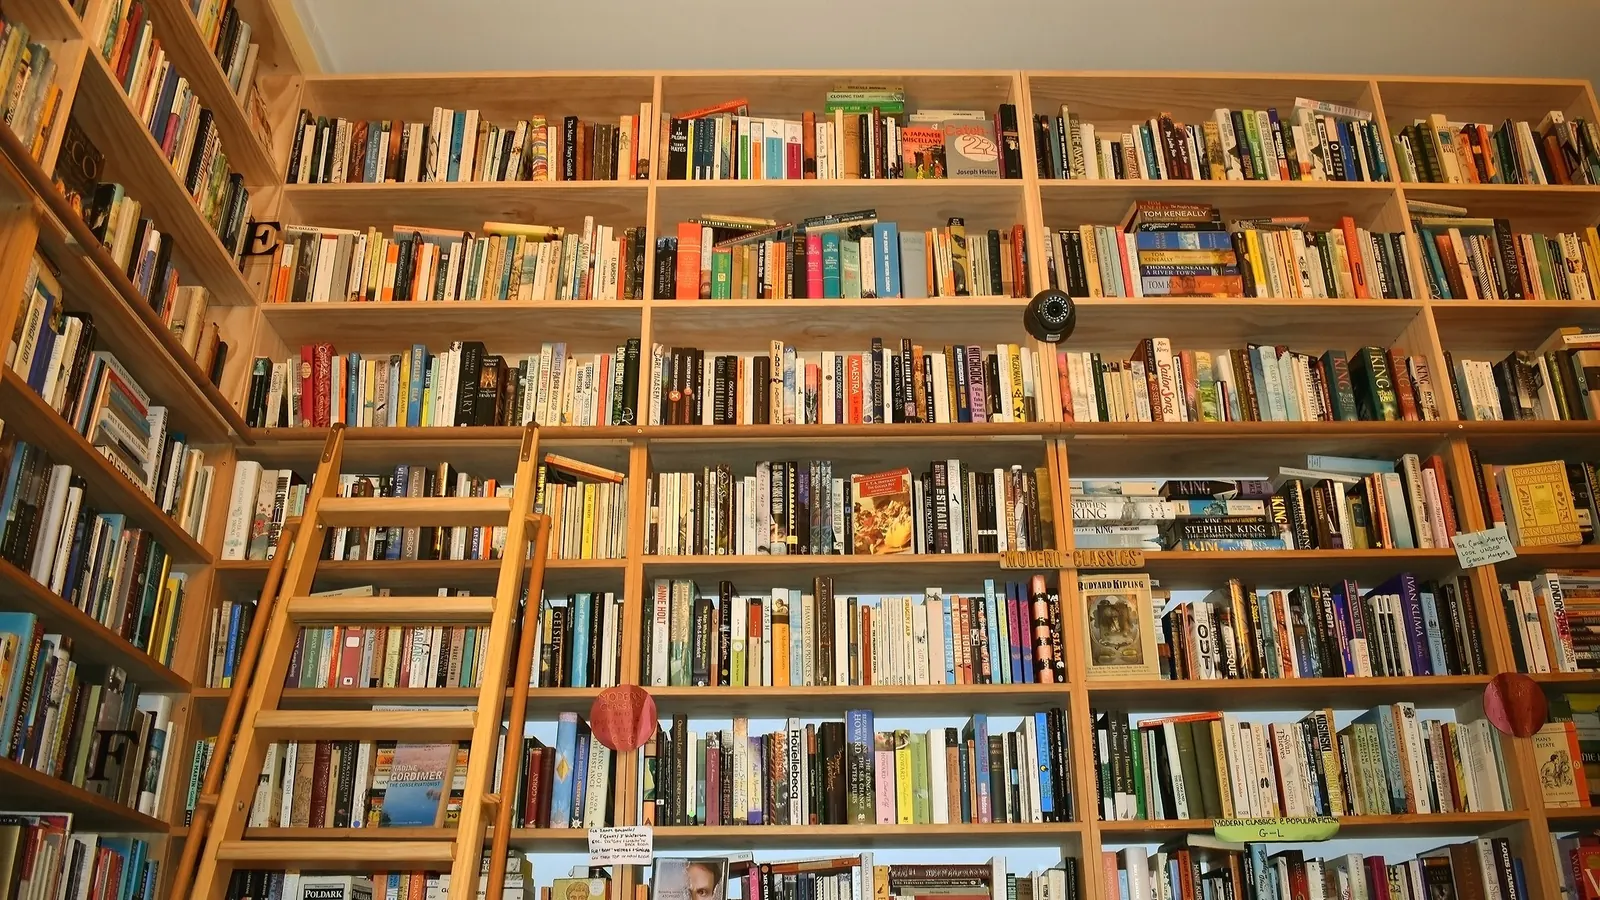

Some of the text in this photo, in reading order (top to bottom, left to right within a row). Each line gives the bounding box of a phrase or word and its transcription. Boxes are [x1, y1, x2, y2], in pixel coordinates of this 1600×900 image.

[1144, 210, 1207, 218] TOM KENEALLY
[246, 221, 281, 255] E
[1147, 277, 1166, 288] TOM
[615, 347, 625, 384] DON BUENO
[968, 347, 982, 385] HITCHCOCK
[1012, 354, 1021, 386] PILGERMANN
[1334, 357, 1350, 390] KING
[1370, 355, 1390, 389] KING
[1394, 356, 1410, 387] KING
[1417, 365, 1430, 385] KING
[553, 371, 561, 389] PARIS
[576, 370, 584, 394] GERRITSEN
[653, 372, 661, 399] HIAASEN
[874, 360, 882, 406] LOST HORIZON
[1157, 360, 1174, 415] Sailor Song
[462, 381, 474, 415] MARY
[1512, 464, 1560, 476] NORMAN
[1516, 474, 1562, 484] MAILER
[1180, 482, 1210, 495] KING
[936, 495, 947, 530] STRAIN
[1006, 500, 1015, 543] UNFEELING
[1072, 508, 1107, 519] KING
[1271, 497, 1288, 524] KING
[1095, 525, 1113, 534] KING
[1185, 524, 1265, 534] STEPHEN KING
[1522, 524, 1578, 536] ANCIENT
[1523, 534, 1582, 546] EVENINGS
[406, 529, 414, 557] GIBSON
[1188, 540, 1223, 551] KING
[1005, 551, 1137, 568] MODERN CLASSICS
[1078, 579, 1144, 591] RUDYARD KIPLING
[1405, 576, 1418, 602] IVAN
[657, 585, 666, 624] ANNE HOLT
[1322, 589, 1334, 628] klavan
[1350, 595, 1359, 616] RUNNING
[552, 611, 561, 651] GEISHA
[1354, 617, 1362, 632] MATE
[954, 634, 962, 668] HORNBY
[962, 634, 971, 669] HORNBY
[1052, 632, 1063, 662] SLAM
[1198, 624, 1211, 669] OUT
[599, 692, 642, 702] MODERN
[1276, 729, 1286, 759] Thieves
[1316, 714, 1331, 752] KOSINSKI
[391, 771, 442, 781] GORDIMER
[394, 764, 418, 772] NADINE
[791, 730, 799, 799] Houellebecq
[1323, 752, 1338, 789] PASSION
[1286, 780, 1295, 810] Kostova
[1214, 818, 1244, 826] MODERN
[1246, 818, 1276, 826] CLASSICS
[1500, 842, 1510, 867] LOUIS
[305, 890, 343, 898] POLDARK
